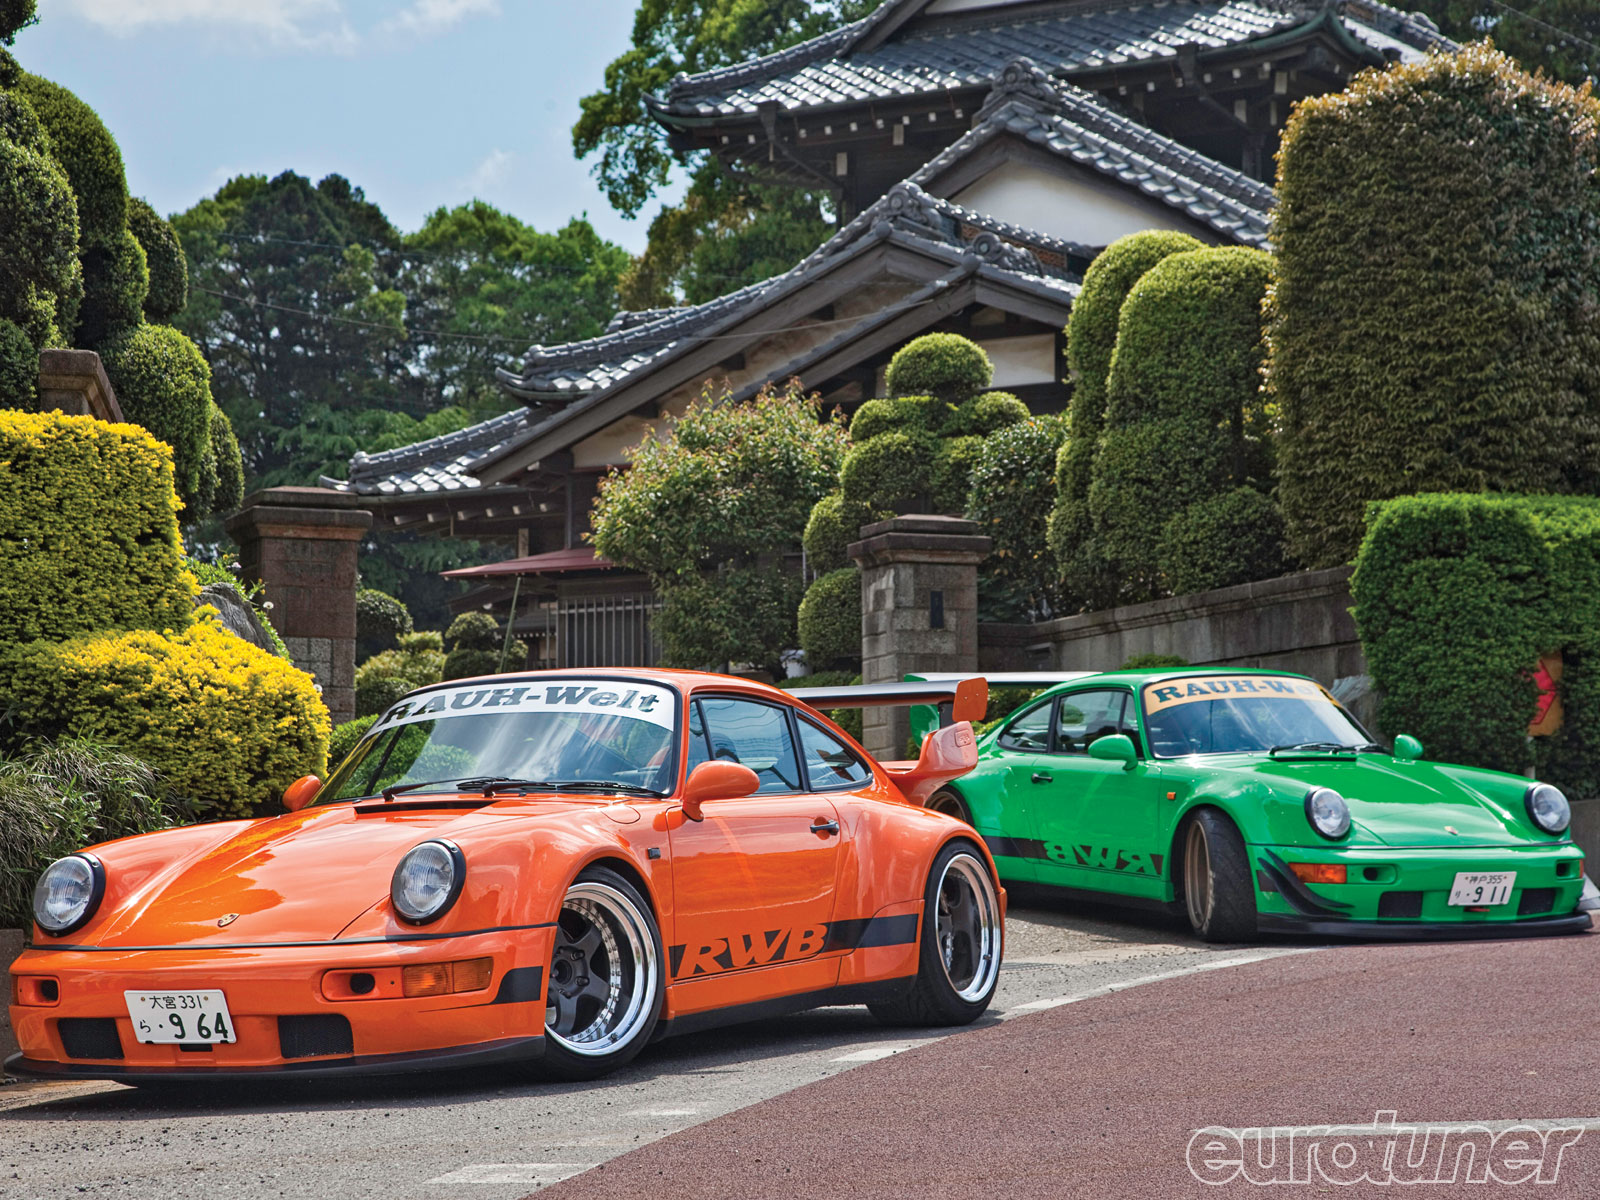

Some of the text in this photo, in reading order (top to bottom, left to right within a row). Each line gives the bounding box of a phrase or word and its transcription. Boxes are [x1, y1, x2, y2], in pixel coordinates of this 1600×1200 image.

[376, 686, 660, 728] RAUH-Welt
[676, 923, 829, 978] RWB
[139, 1019, 152, 1034] ら
